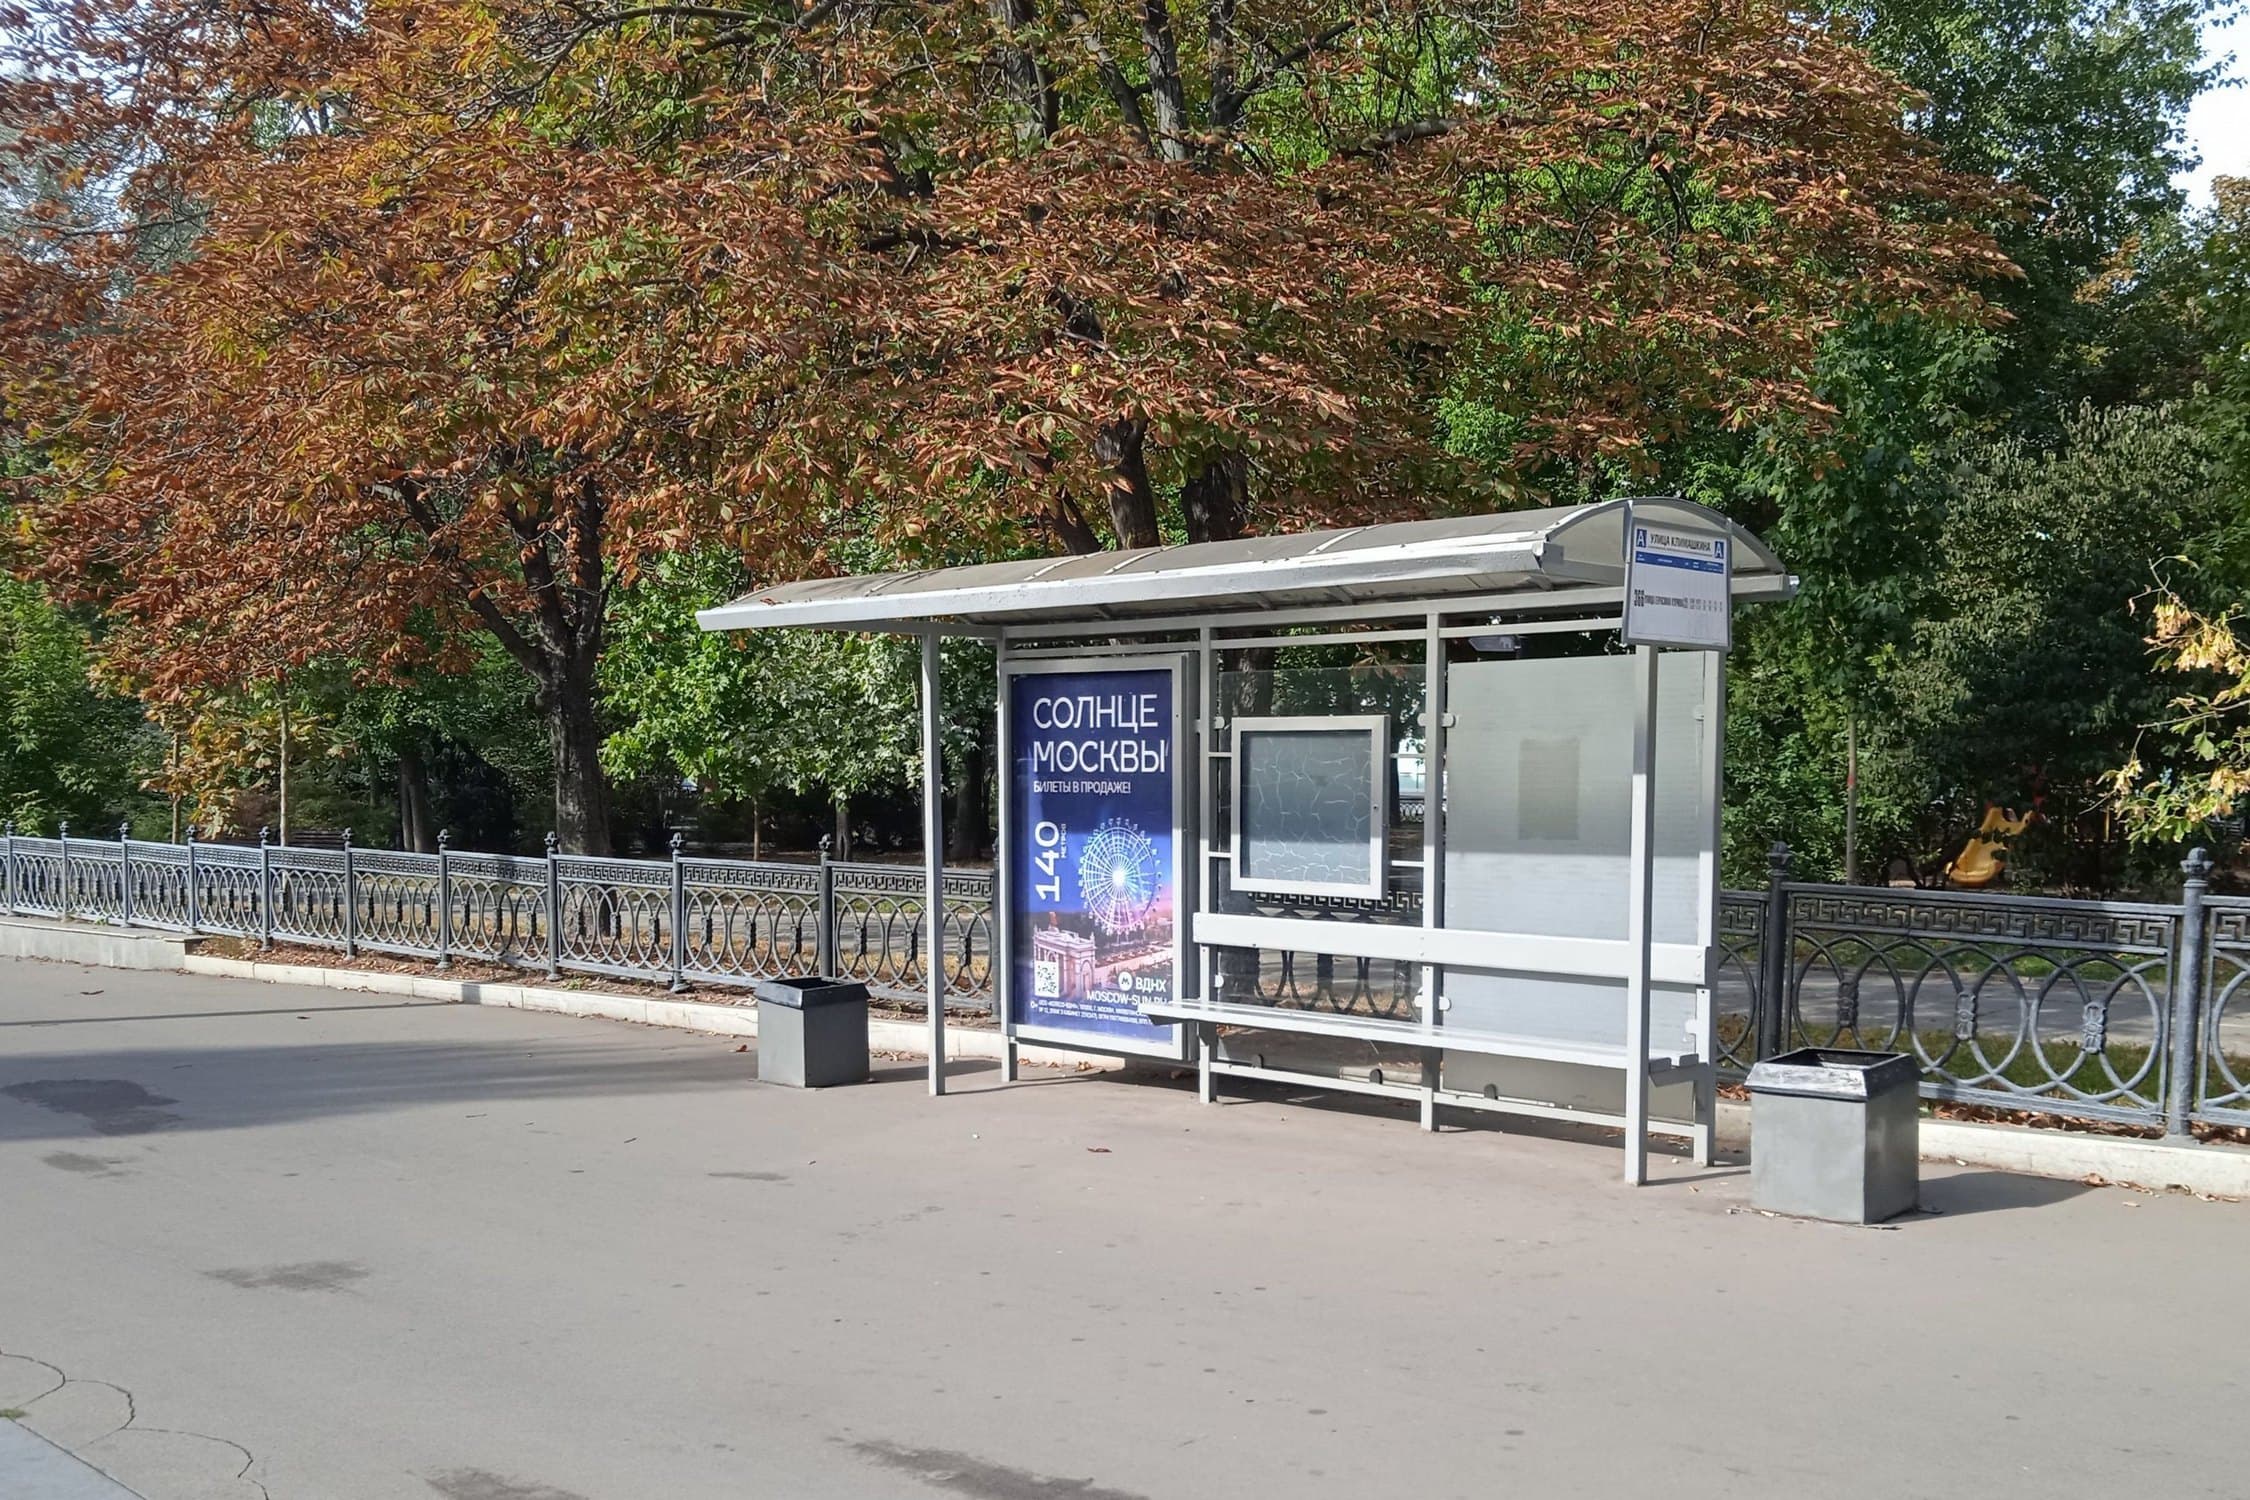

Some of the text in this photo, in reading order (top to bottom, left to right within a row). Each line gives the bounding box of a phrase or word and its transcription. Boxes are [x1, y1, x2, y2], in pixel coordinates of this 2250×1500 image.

[1650, 534, 1670, 546] УЛИЦА
[1033, 694, 1158, 733] СОЛНЦЕ
[1033, 740, 1166, 773] МОСКВЫ
[1033, 781, 1131, 795] БИЛЕТЫ В ПРОДАЖЕ!
[1060, 823, 1068, 859] МЕТРОВ
[1034, 820, 1061, 903] 140
[1136, 977, 1167, 993] ВДНХ
[1086, 990, 1168, 1006] MOSCOW-SUNRU
